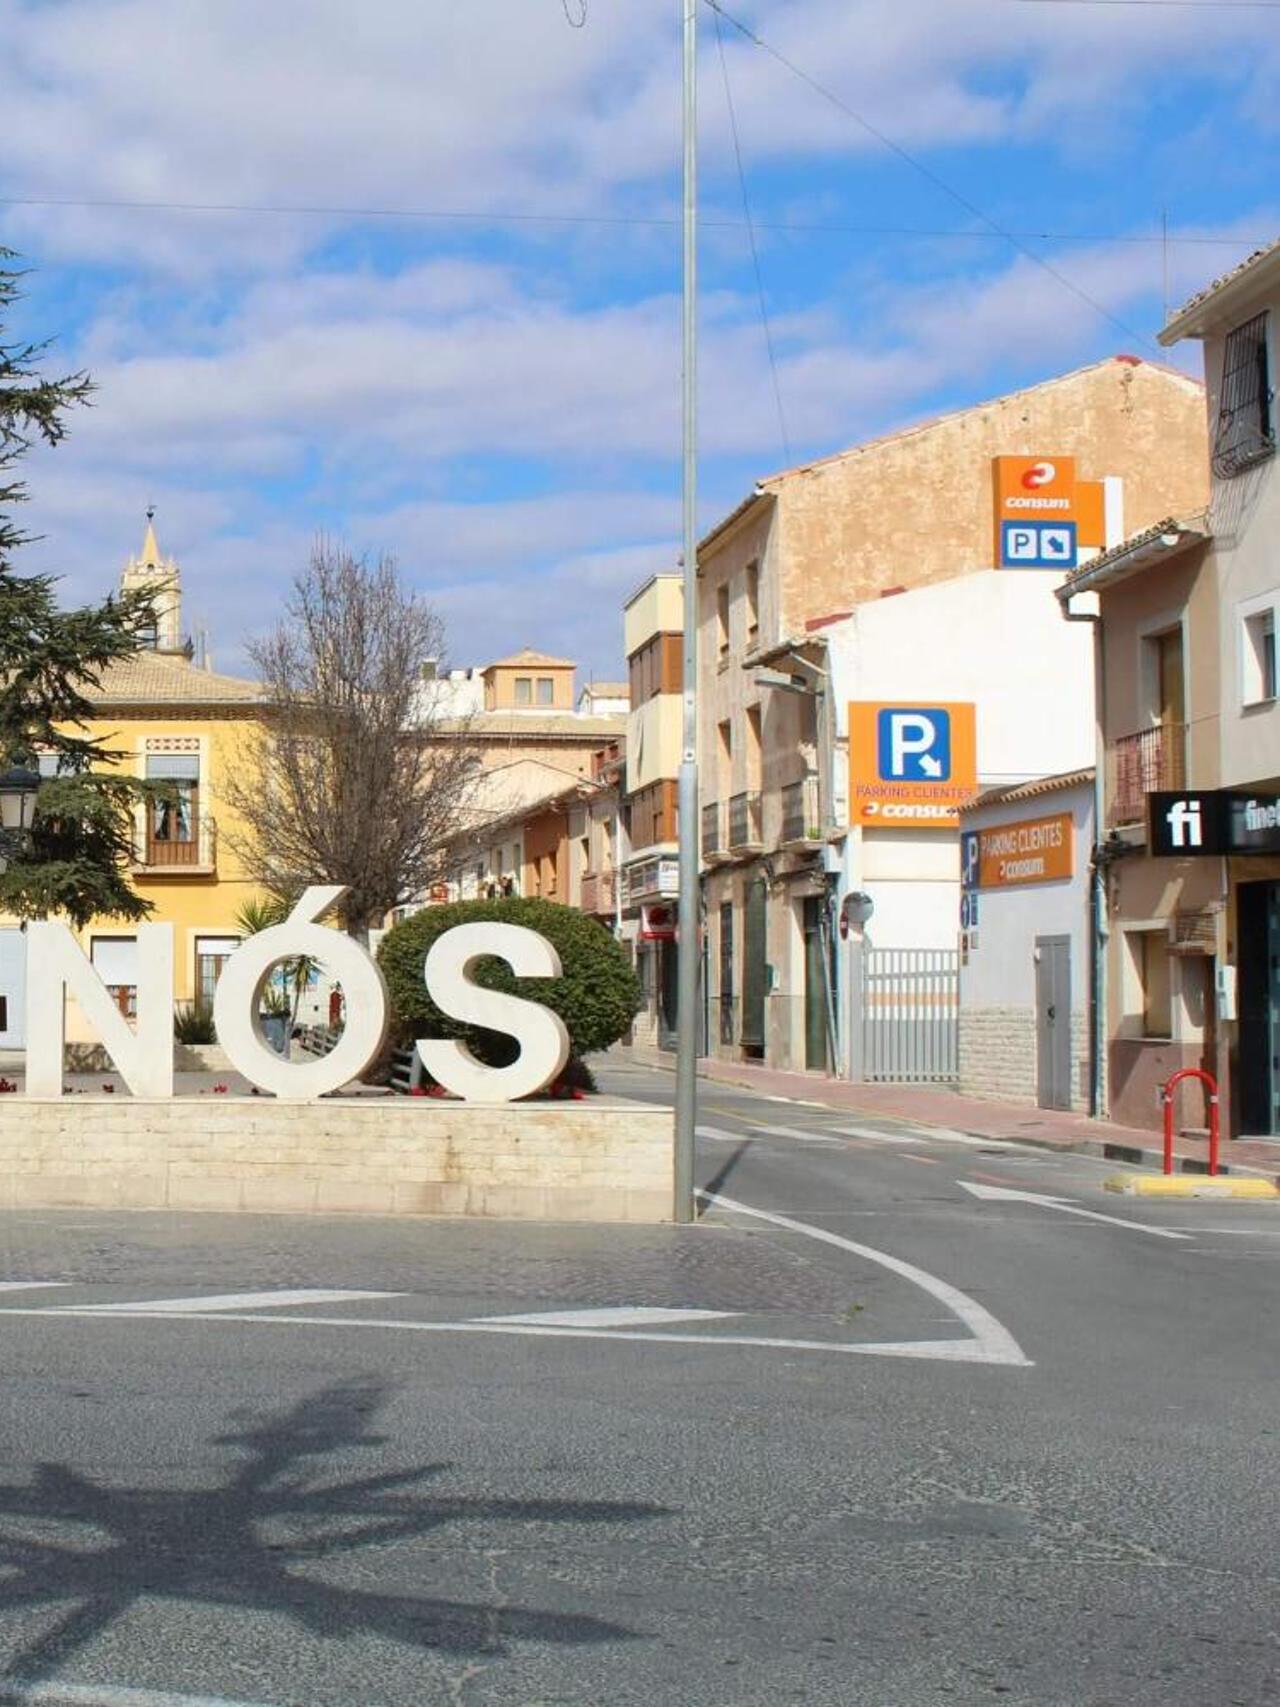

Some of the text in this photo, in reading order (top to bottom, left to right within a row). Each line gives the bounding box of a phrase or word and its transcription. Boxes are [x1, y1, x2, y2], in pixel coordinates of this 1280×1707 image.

[1005, 497, 1070, 511] consum
[1014, 533, 1030, 554] P
[891, 714, 936, 776] P
[856, 784, 909, 799] PARKING
[1018, 821, 1062, 853] CLIENTES
